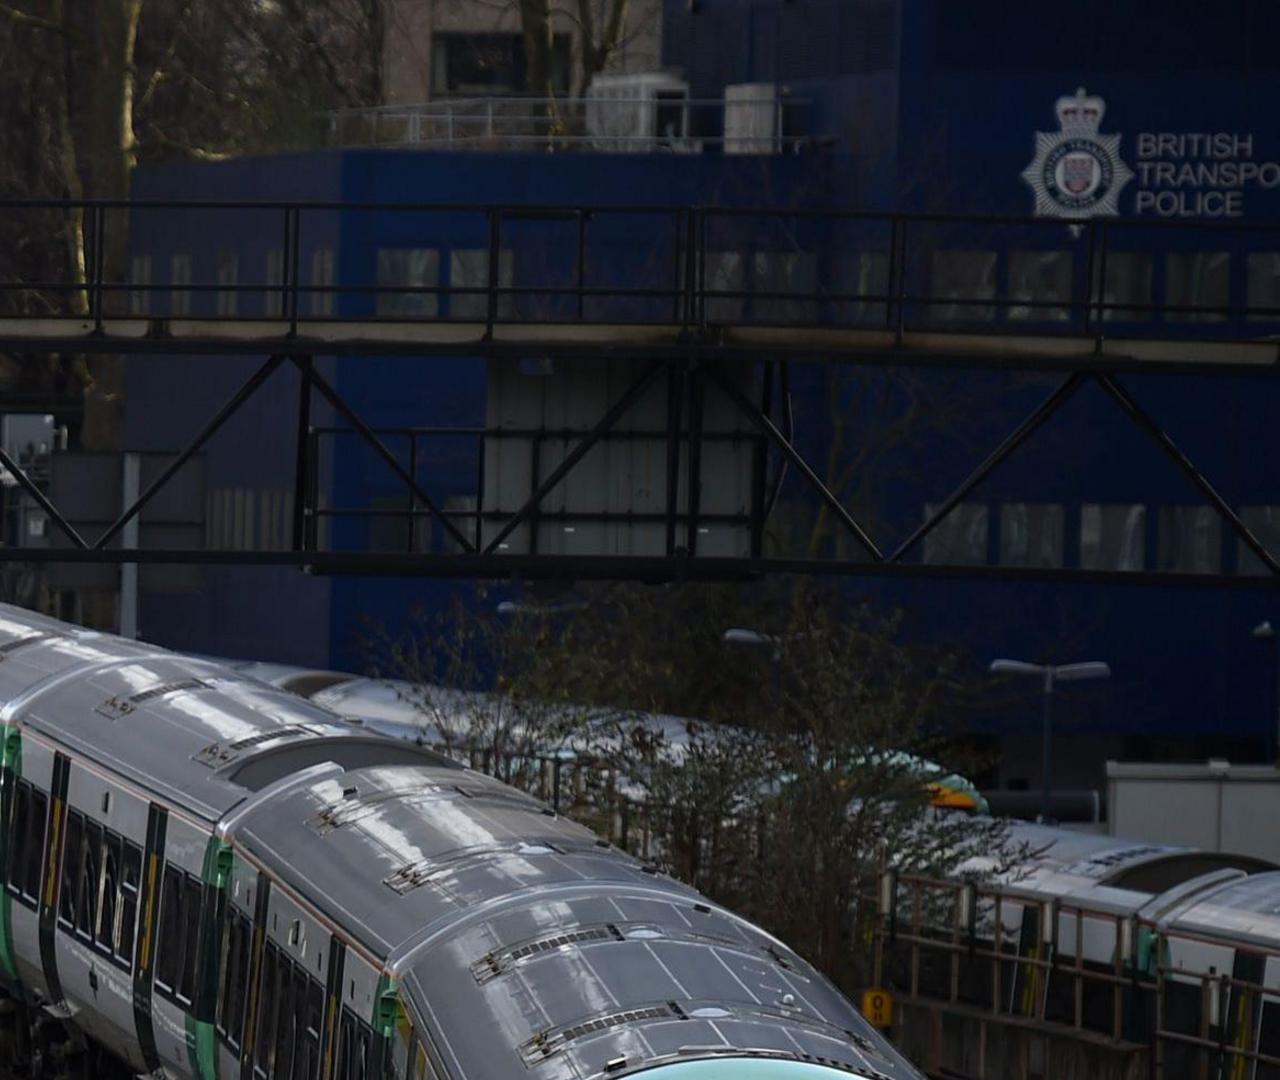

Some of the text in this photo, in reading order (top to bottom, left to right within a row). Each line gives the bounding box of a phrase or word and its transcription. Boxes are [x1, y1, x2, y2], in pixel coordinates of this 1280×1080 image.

[1137, 133, 1253, 158] BRITISH
[1137, 161, 1280, 187] TRANSPO
[1136, 190, 1244, 216] POLICE
